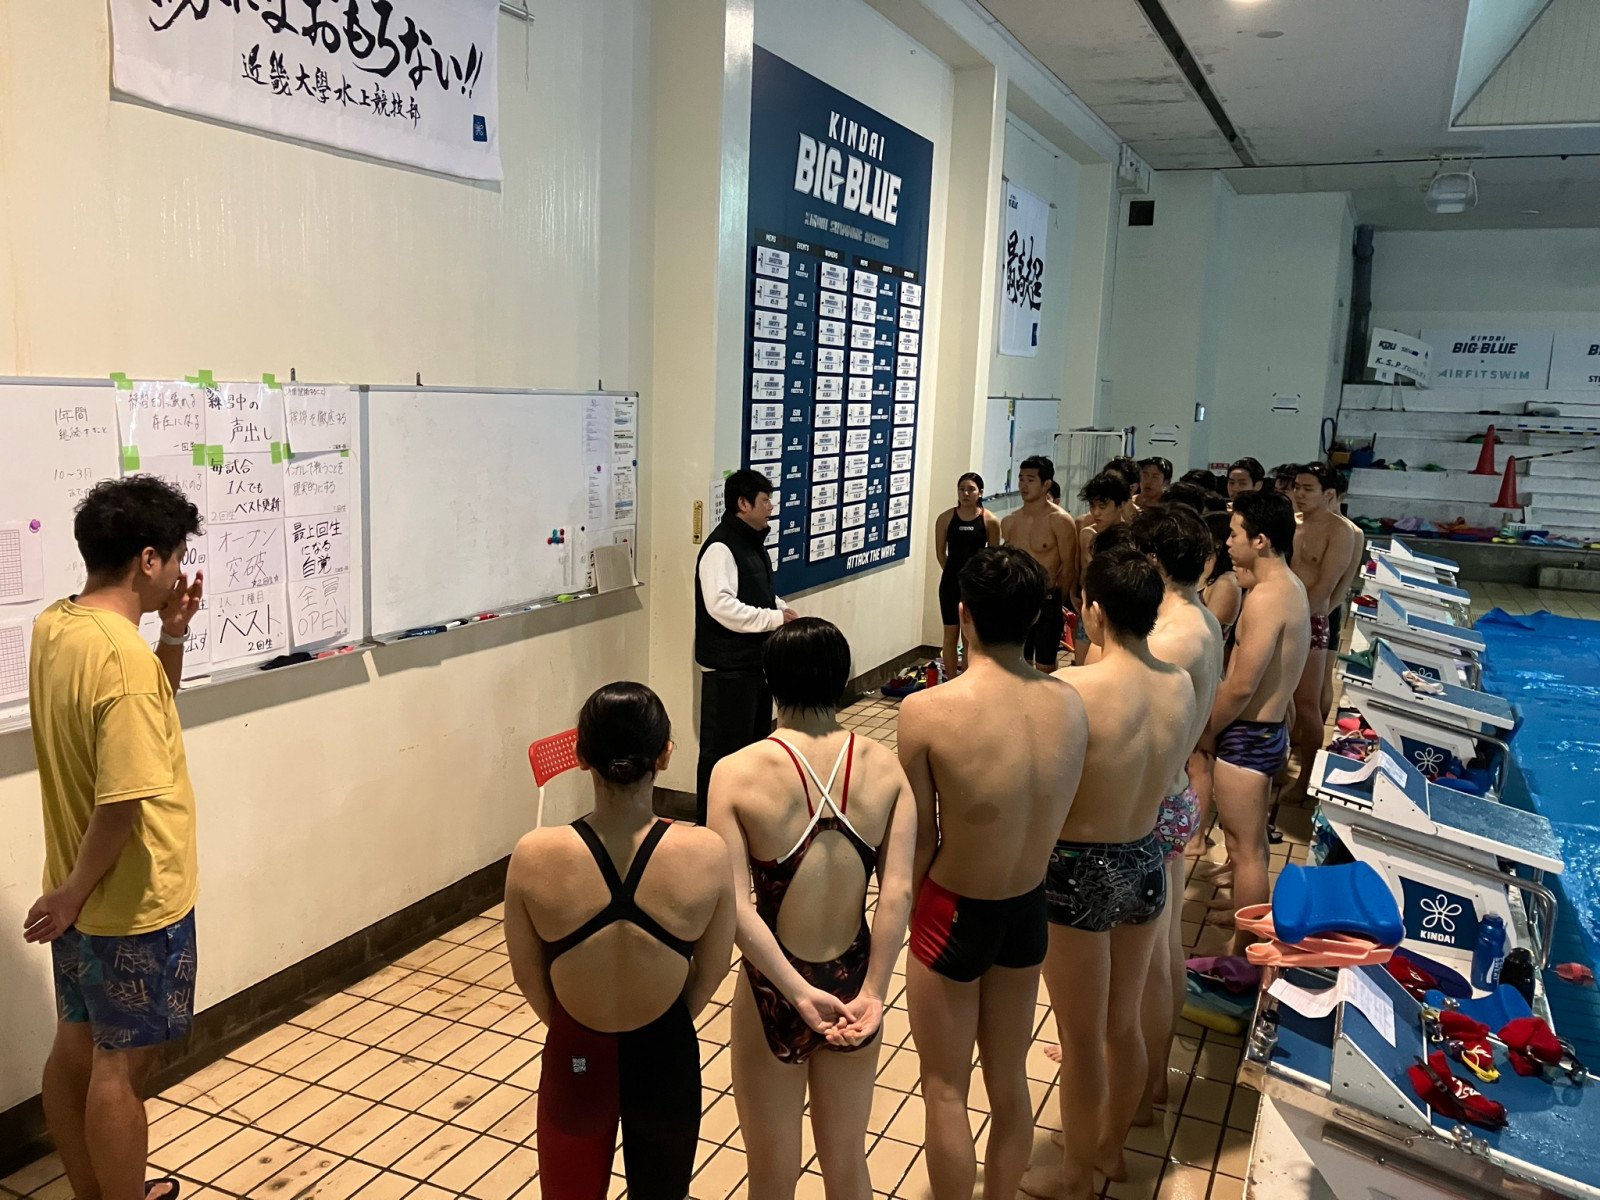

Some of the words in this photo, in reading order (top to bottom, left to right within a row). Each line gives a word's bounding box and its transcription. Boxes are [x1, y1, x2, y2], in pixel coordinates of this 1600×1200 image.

[828, 110, 886, 162] KINDAI
[794, 132, 845, 205] BIG
[843, 153, 902, 226] BLUE
[1452, 343, 1480, 354] BIG
[1480, 342, 1519, 355] BLUE
[230, 417, 273, 444] 声出し
[292, 521, 343, 543] 最上回生
[301, 540, 331, 556] になる
[846, 551, 869, 570] ATTACK
[869, 548, 881, 562] THE
[226, 550, 267, 588] 突破
[298, 605, 348, 637] OPEN
[248, 640, 273, 652] 2回生
[1420, 930, 1455, 944] KINDAI
